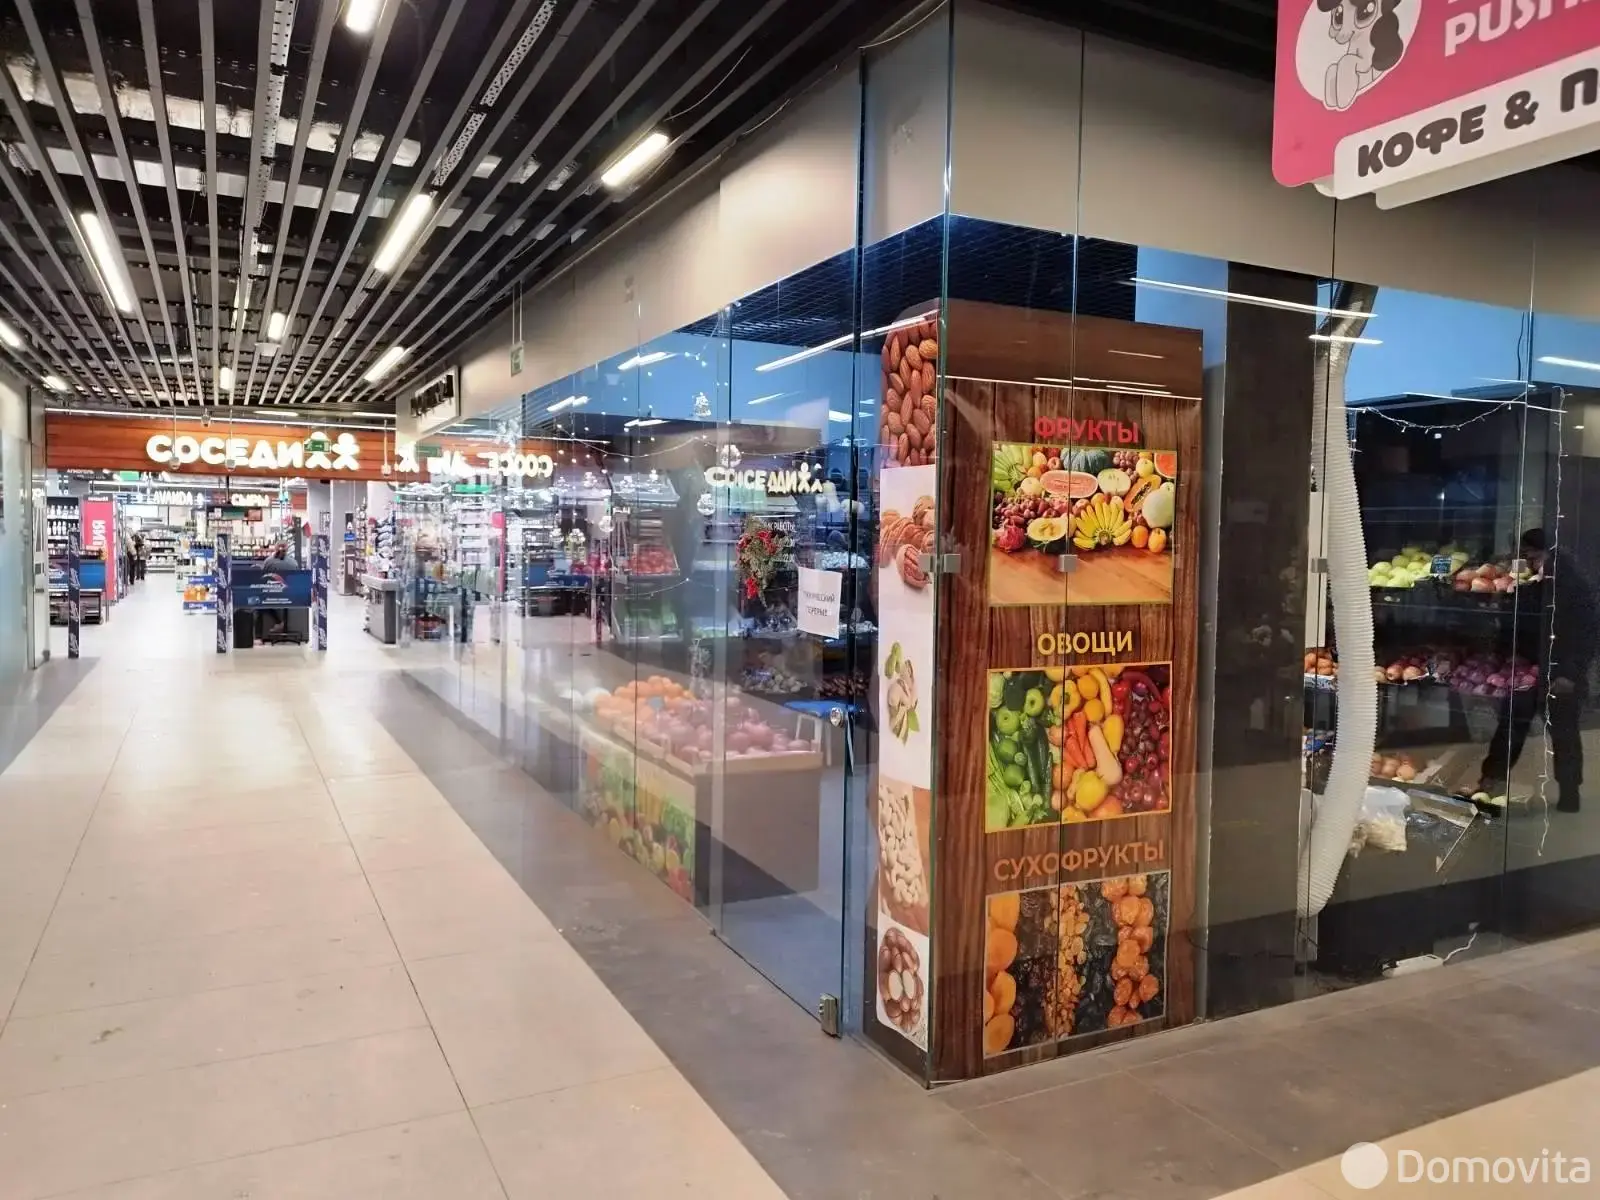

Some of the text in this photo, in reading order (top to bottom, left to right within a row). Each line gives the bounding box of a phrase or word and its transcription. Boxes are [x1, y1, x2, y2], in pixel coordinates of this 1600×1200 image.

[1445, 0, 1600, 57] PUS
[1357, 67, 1600, 178] КОФЕ & П
[1034, 415, 1139, 443] ФРУКТЫ
[146, 434, 304, 469] СОСЕДИ
[1037, 630, 1133, 656] ОВОЩИ
[993, 839, 1165, 881] СУХОФРУКТЫ
